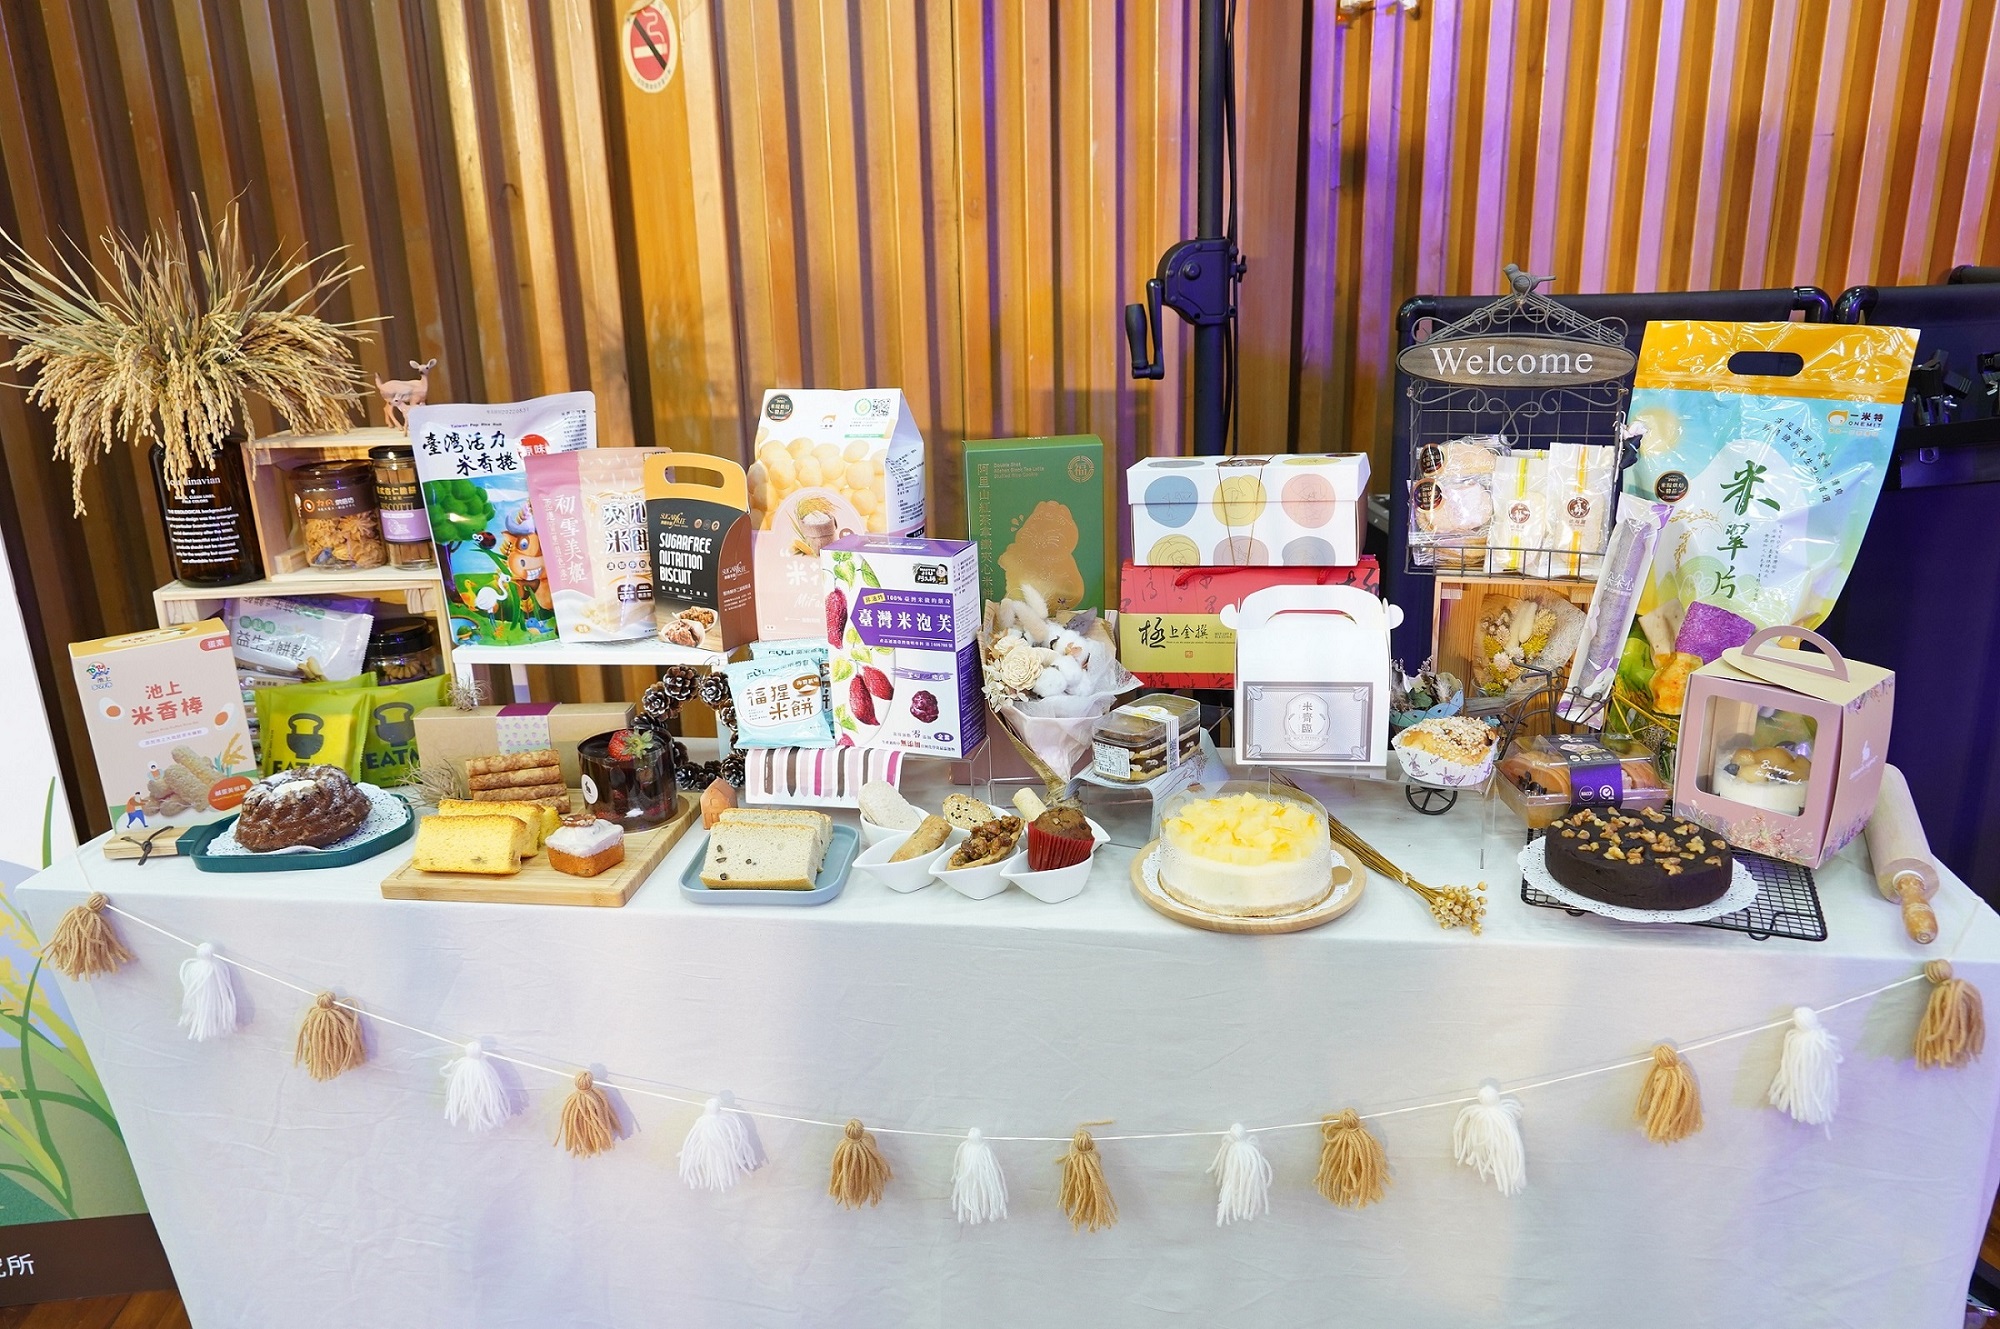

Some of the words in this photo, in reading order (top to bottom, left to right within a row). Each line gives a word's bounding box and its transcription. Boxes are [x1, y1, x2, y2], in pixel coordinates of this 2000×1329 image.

[1430, 346, 1593, 376] Welcome
[1850, 411, 1884, 422] 一米特
[422, 430, 505, 457] 臺灣活力
[456, 451, 518, 476] 米香捲
[659, 532, 713, 554] SUGARFREE
[659, 549, 703, 570] NUTRITION
[659, 565, 692, 585] BISCUIT
[857, 608, 953, 633] 臺灣米泡芙
[145, 681, 182, 700] 池上
[746, 683, 790, 706] 福猩
[131, 696, 203, 726] 米香棒
[769, 697, 814, 720] 米餅
